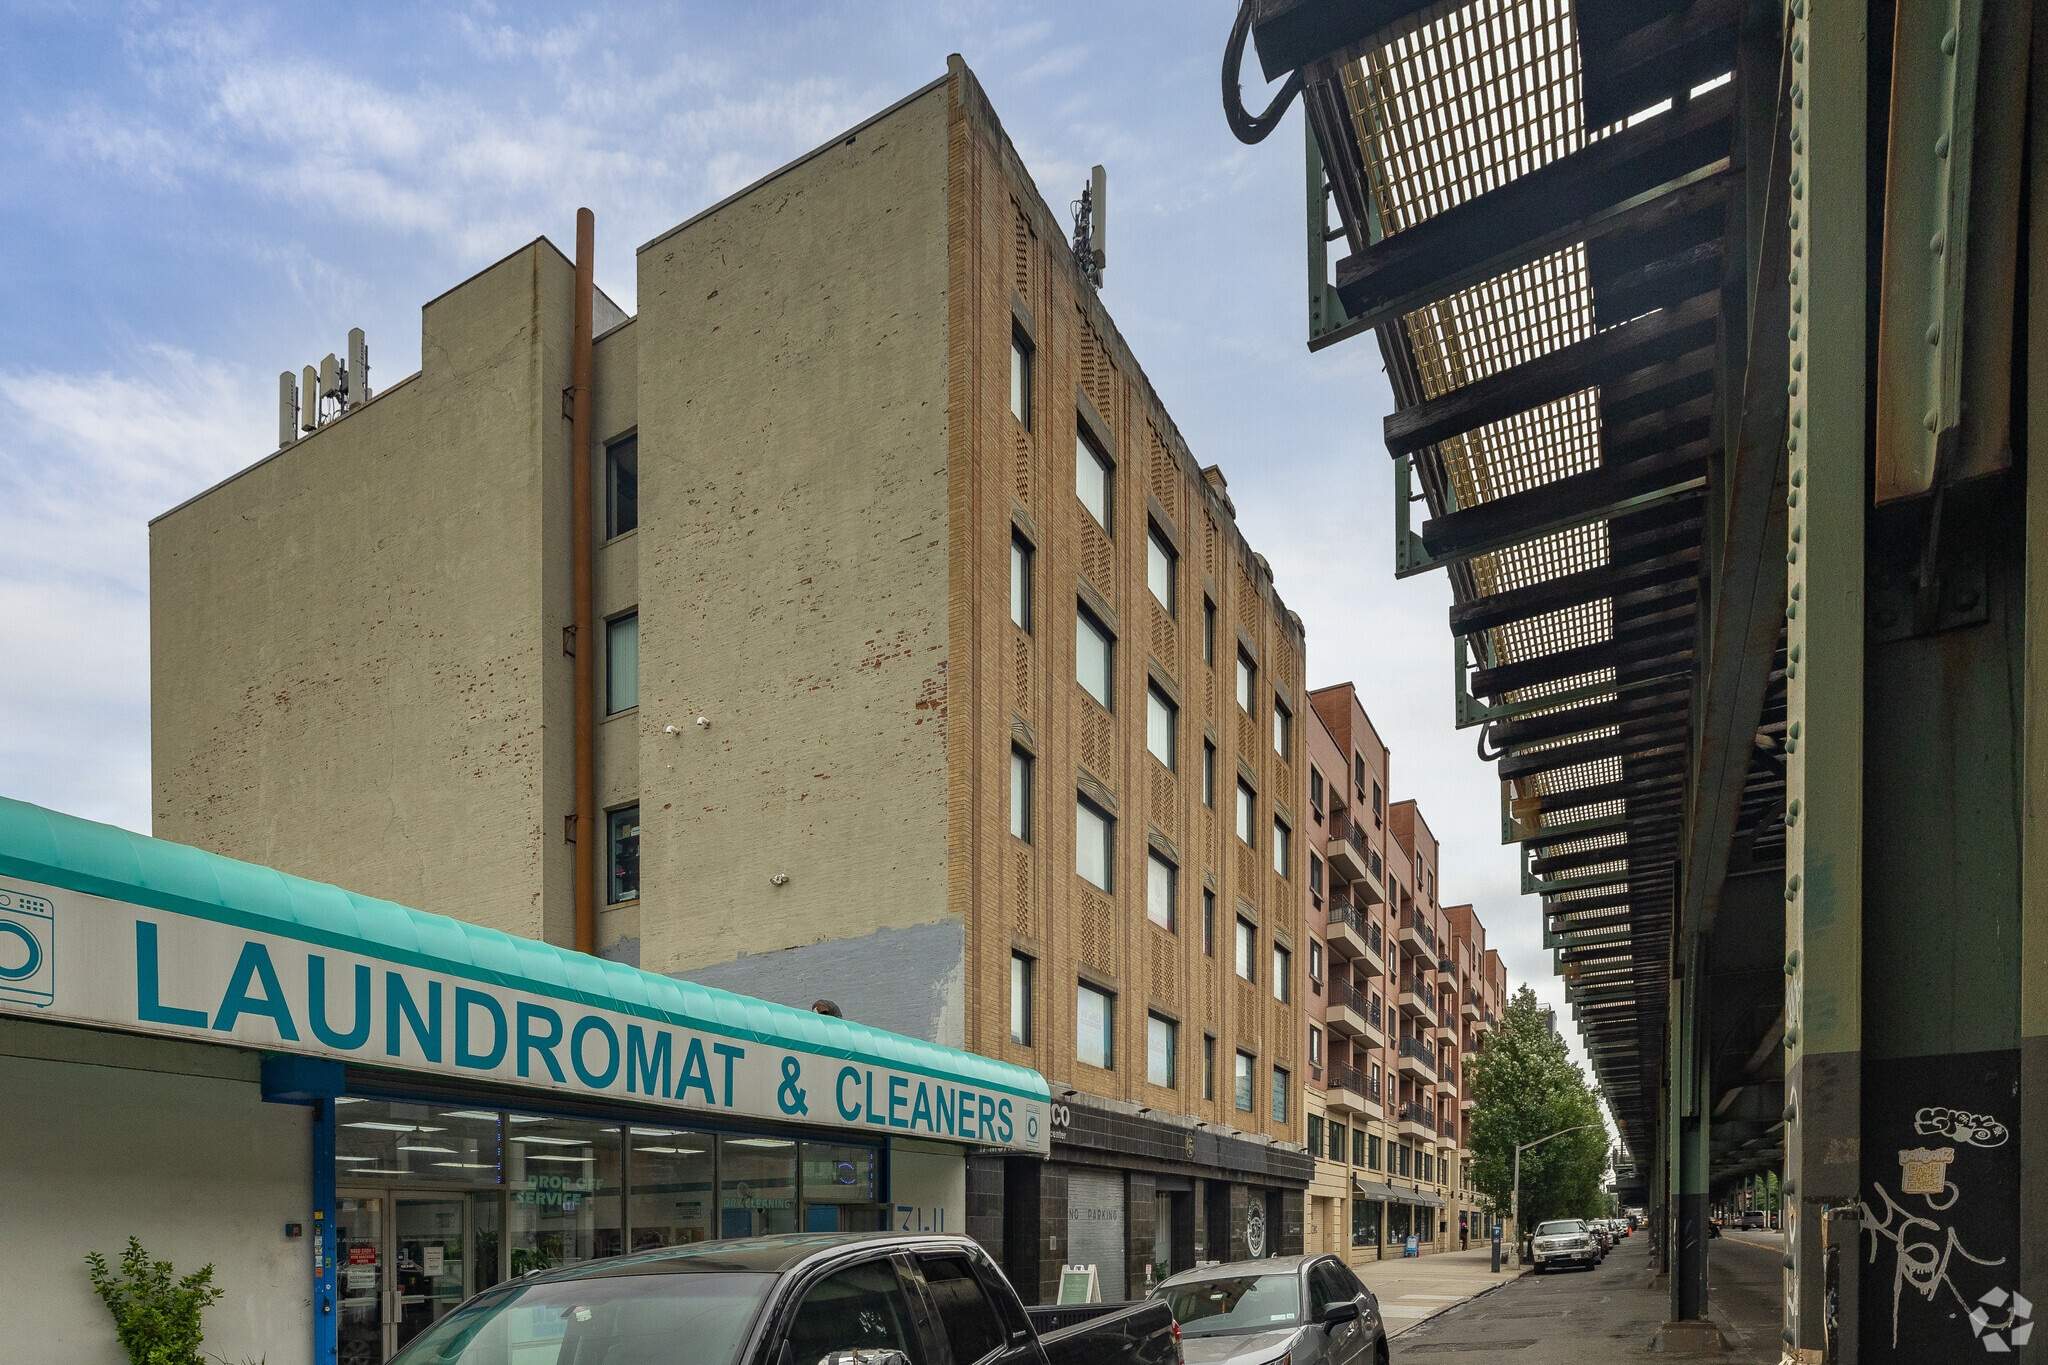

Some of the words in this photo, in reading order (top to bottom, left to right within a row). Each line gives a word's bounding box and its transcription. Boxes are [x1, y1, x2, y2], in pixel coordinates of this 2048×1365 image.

[136, 920, 745, 1107] LAUNDROMAT
[777, 1056, 808, 1117] &
[836, 1066, 1014, 1143] CLEANERS
[527, 1175, 570, 1189] DROP
[575, 1178, 603, 1191] OFF
[516, 1191, 582, 1206] SERVICE
[723, 1198, 743, 1209] DRY
[746, 1198, 790, 1210] CLEANING
[1069, 1209, 1079, 1220] NO
[1087, 1209, 1118, 1221] PARKING
